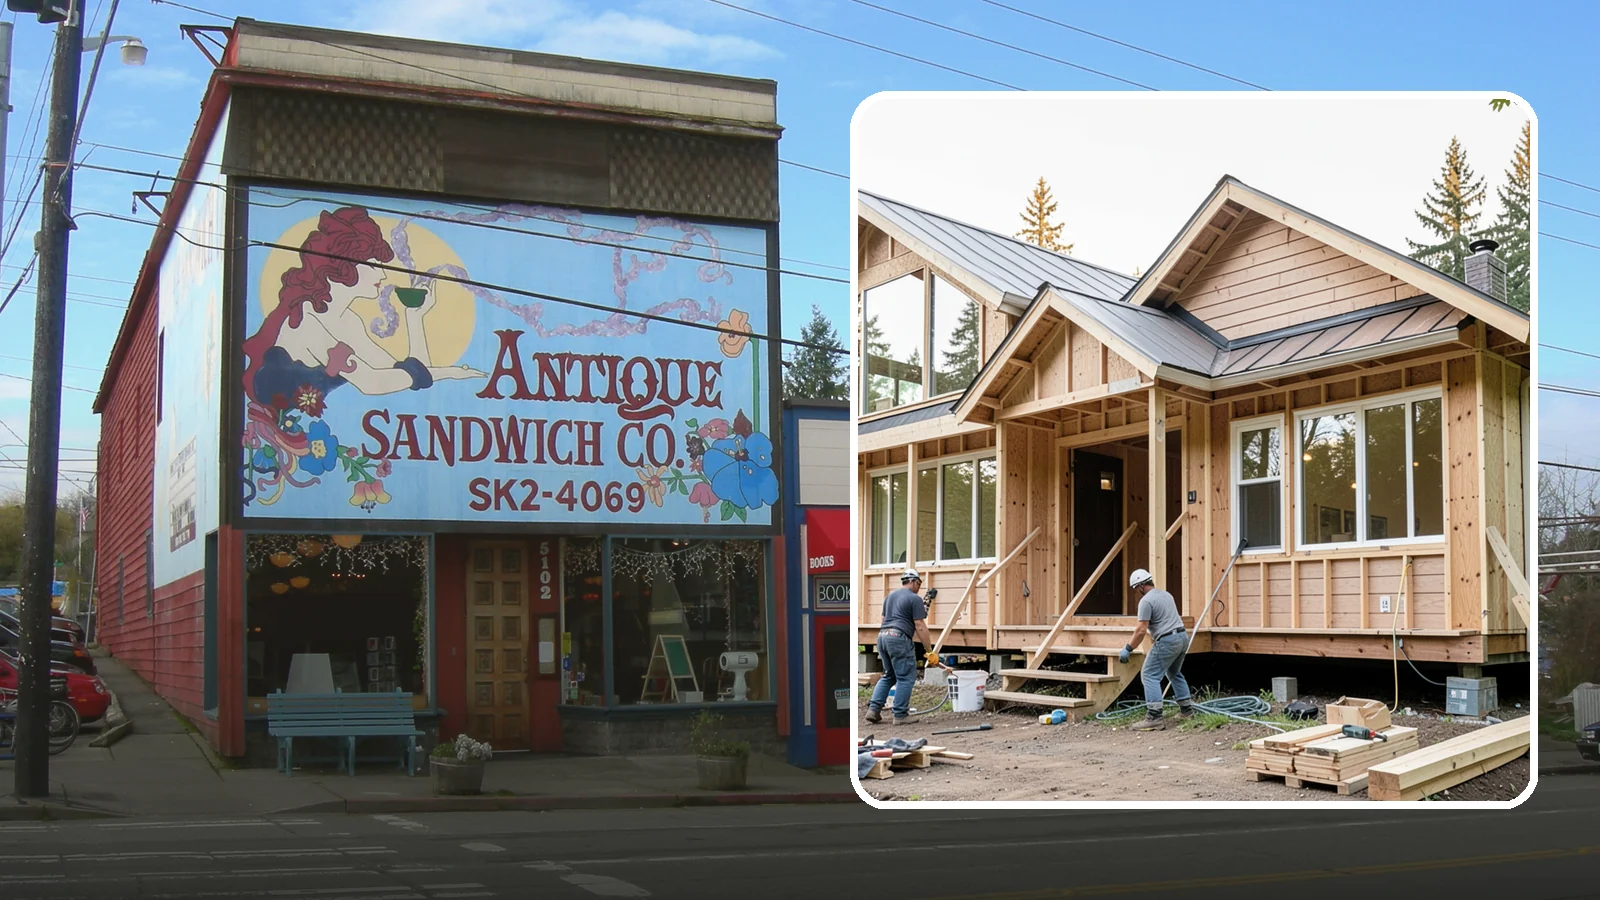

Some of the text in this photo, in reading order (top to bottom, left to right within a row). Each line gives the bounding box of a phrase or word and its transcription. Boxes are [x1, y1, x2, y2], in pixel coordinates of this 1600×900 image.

[475, 329, 723, 421] ANTIQUE
[361, 409, 685, 469] SANDWICH CO.
[468, 477, 646, 513] SK2-4069
[540, 541, 551, 600] 5102
[809, 555, 835, 569] BOOKS
